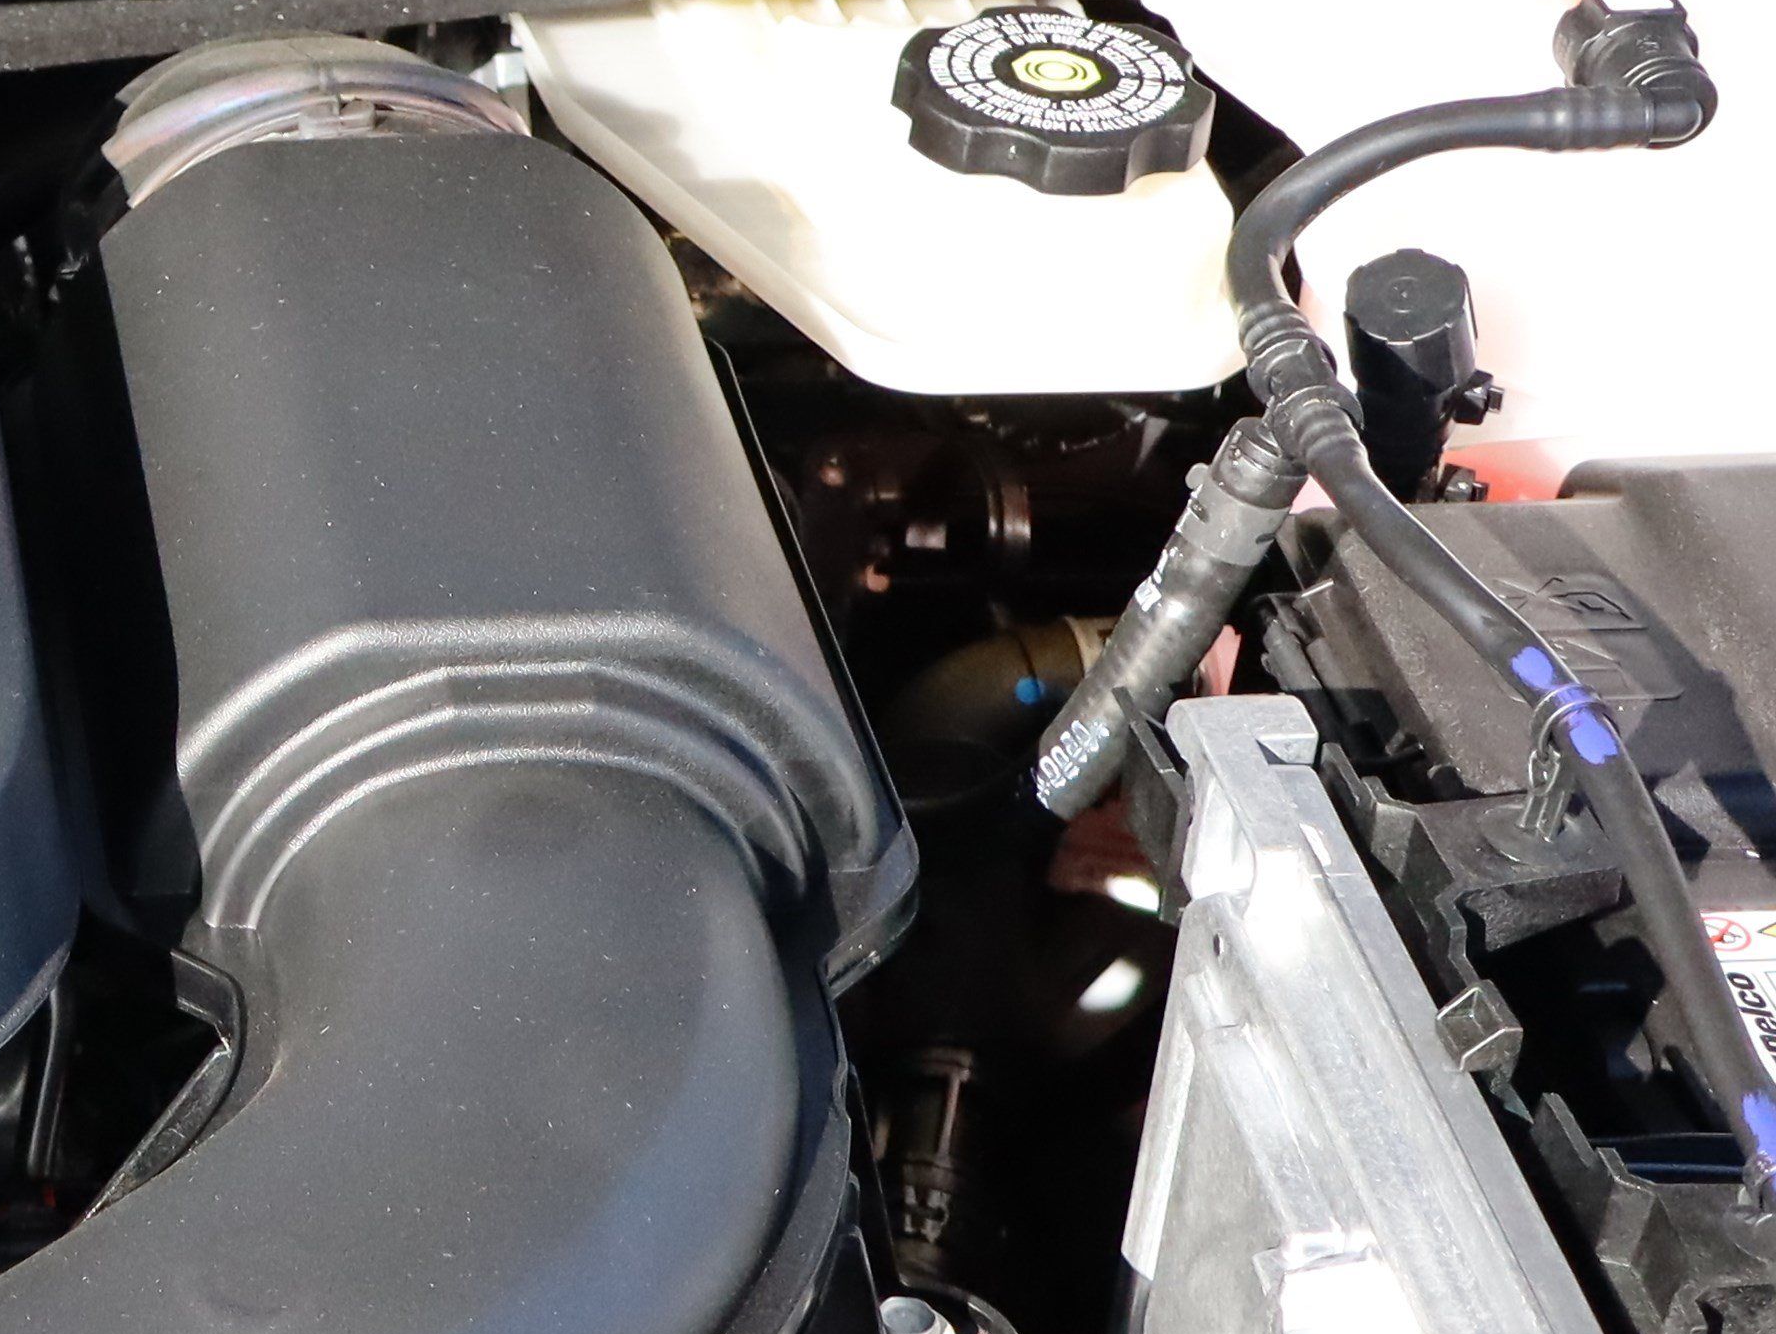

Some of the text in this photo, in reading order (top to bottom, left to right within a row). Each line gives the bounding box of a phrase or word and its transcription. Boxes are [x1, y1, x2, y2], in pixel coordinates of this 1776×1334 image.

[996, 13, 1019, 26] LE
[1019, 12, 1093, 30] BOUCHON
[1093, 23, 1143, 44] AVANT
[974, 102, 1021, 124] FLUID
[1020, 115, 1067, 133] FROM
[1070, 122, 1082, 133] A
[986, 94, 1044, 118] BEFORE
[1060, 96, 1112, 112] CLEAN
